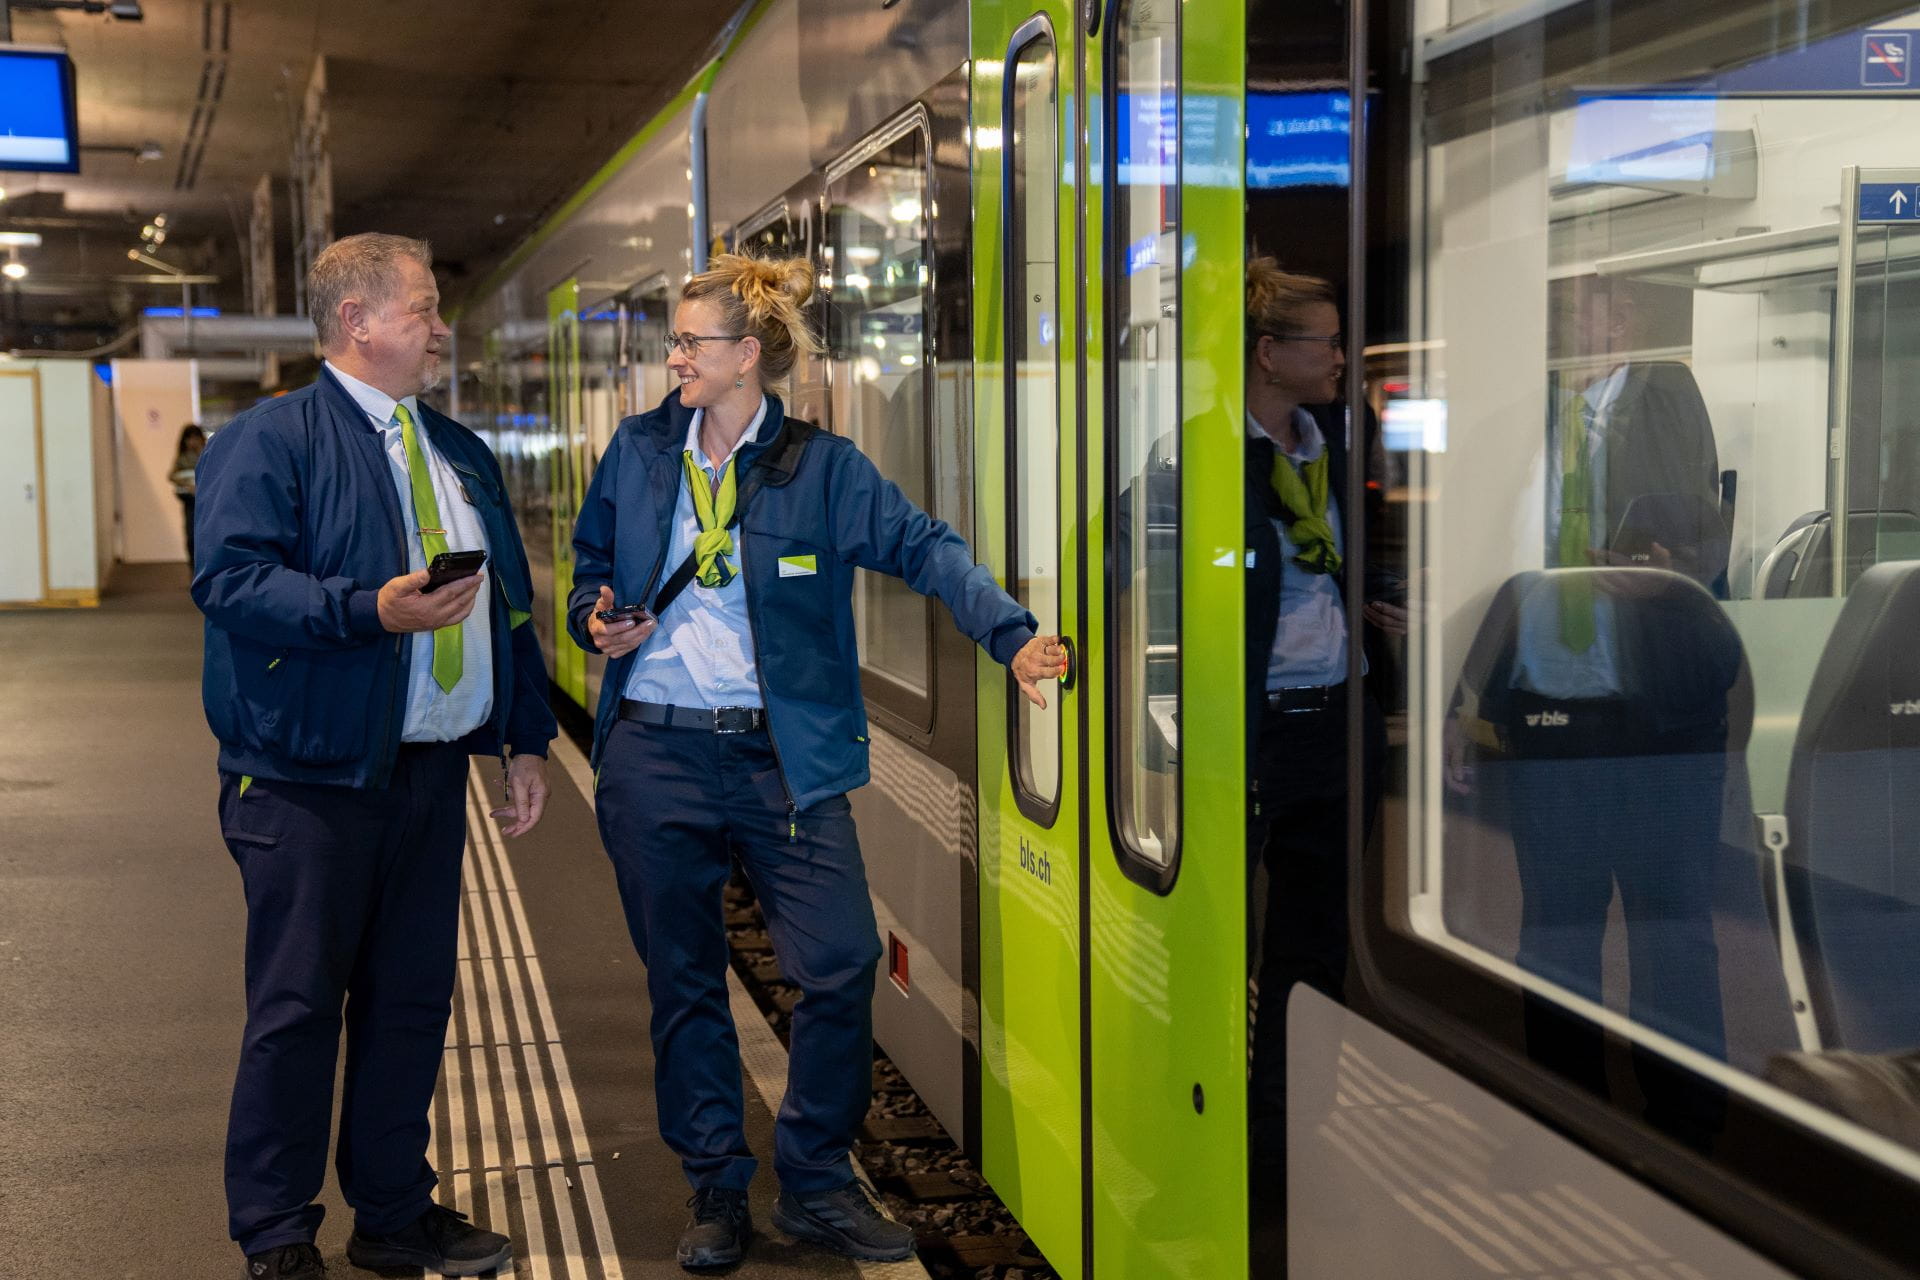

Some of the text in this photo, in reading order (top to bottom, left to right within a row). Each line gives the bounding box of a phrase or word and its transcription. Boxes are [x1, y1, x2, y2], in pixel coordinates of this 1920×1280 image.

[903, 314, 915, 334] 2
[1541, 710, 1569, 727] bls
[1020, 835, 1051, 886] bls.ch
